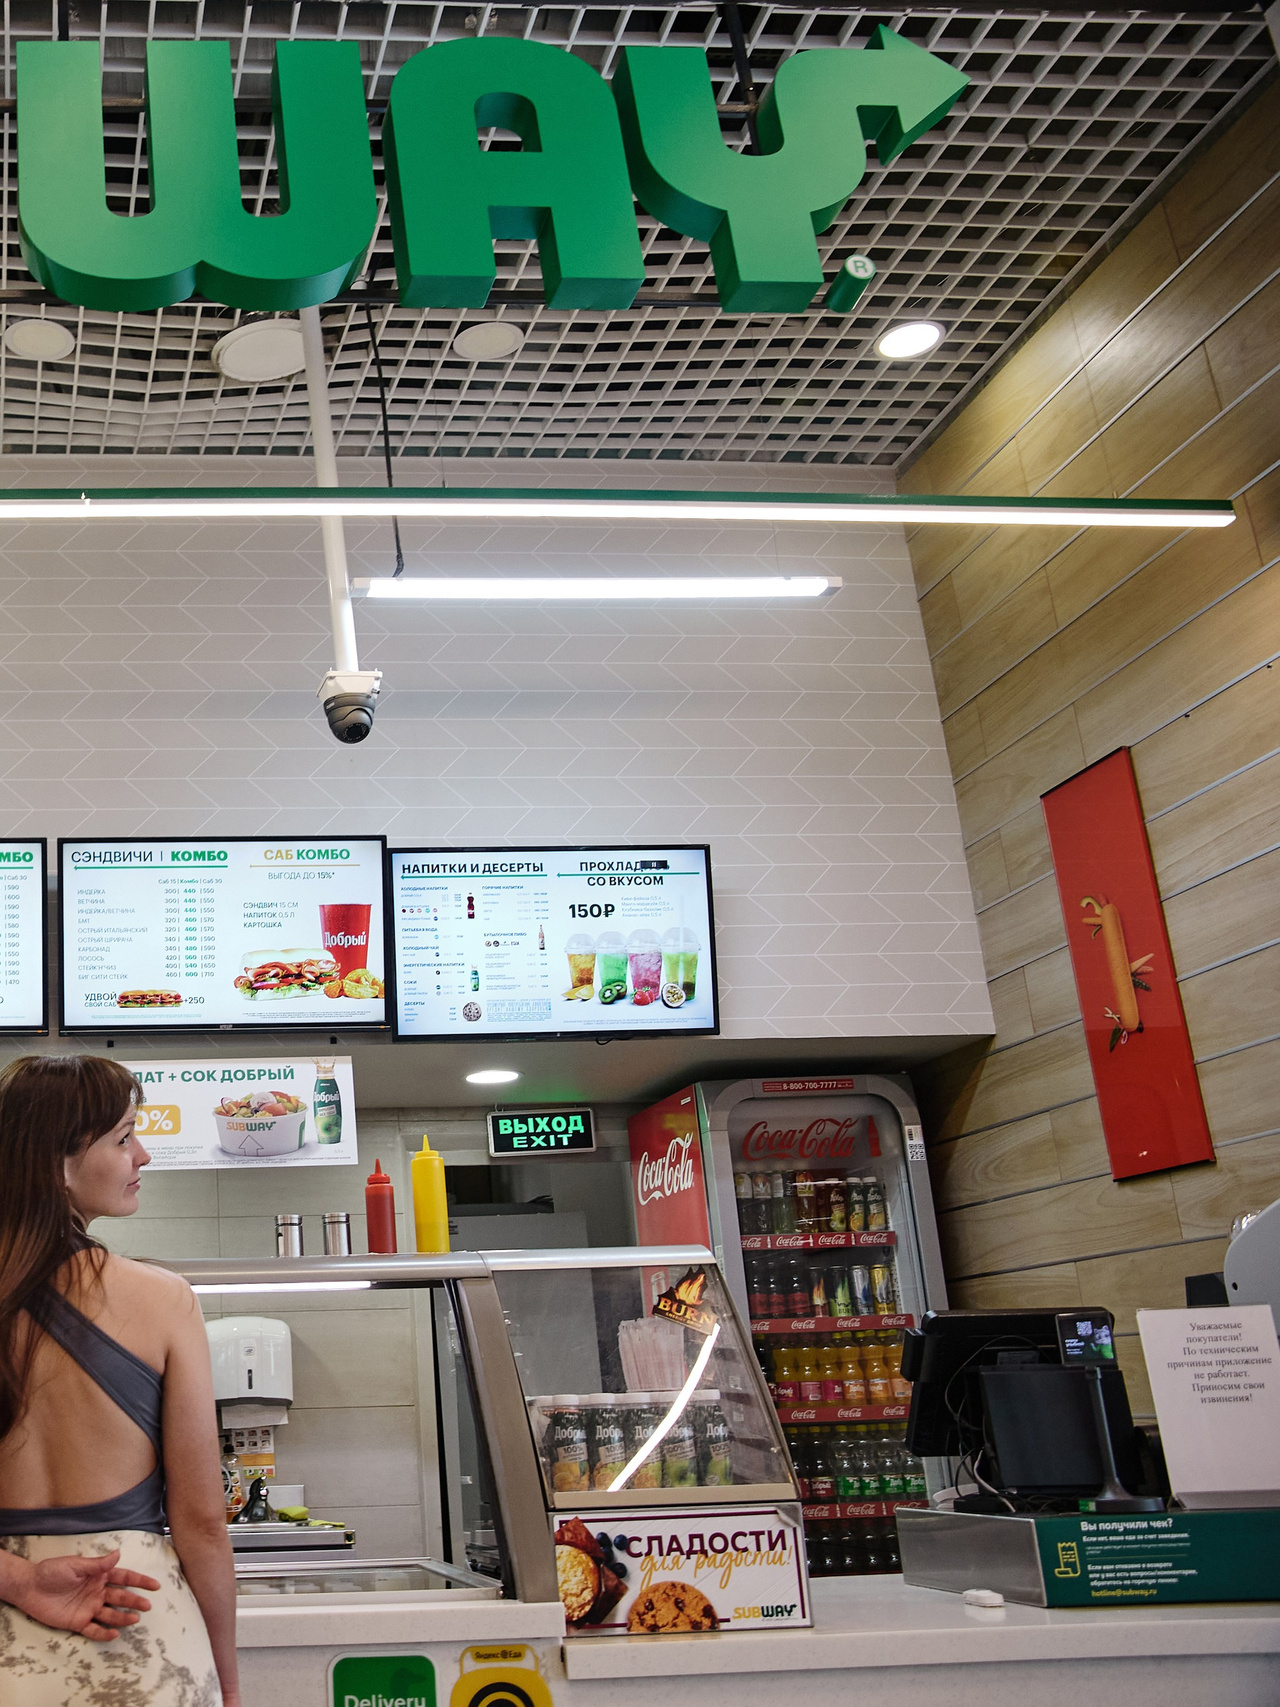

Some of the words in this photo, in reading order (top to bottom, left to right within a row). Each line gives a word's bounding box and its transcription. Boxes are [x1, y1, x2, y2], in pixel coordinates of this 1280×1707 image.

[71, 851, 153, 864] СЭНДВИЧИ
[171, 850, 228, 862] КОМБО
[264, 849, 293, 860] САБ
[297, 849, 350, 860] КОМБО
[402, 864, 466, 874] НАПИТКИ
[471, 864, 479, 873] И
[482, 863, 543, 874] ДЕСЕРТЫ
[580, 861, 669, 872] ПРОХЛАД
[268, 872, 301, 880] ВЫГОДА
[302, 872, 315, 880] ДО
[587, 877, 606, 886] СО
[609, 876, 664, 886] ВКУСОМ
[569, 903, 615, 918] 150₽
[325, 931, 366, 948] Добрый
[85, 992, 117, 1001] УДВОЙ
[184, 996, 205, 1004] +250
[133, 1071, 164, 1083] ЛАТ
[180, 1070, 217, 1083] СОК
[220, 1065, 295, 1084] ДОБРЫЙ
[226, 1121, 277, 1132] SUBWAY
[498, 1115, 585, 1135] ВЫХОД
[512, 1134, 573, 1148] EXIT
[742, 1116, 860, 1162] Coca-Cola
[638, 1131, 695, 1206] Coca-Cola
[776, 1235, 804, 1247] Coca-Cola
[818, 1234, 846, 1245] Coca-Cola
[860, 1233, 888, 1244] Coca-Cola
[658, 1297, 715, 1324] BURN
[791, 1319, 816, 1330] Coca-Cola
[837, 1317, 861, 1327] Coca-Cola
[881, 1316, 906, 1326] Coca-Cola
[1189, 1322, 1242, 1332] Уважаемые
[1186, 1333, 1242, 1344] покупатели!
[1183, 1347, 1196, 1356] По
[1199, 1345, 1259, 1354] техническим
[1167, 1360, 1213, 1370] причинам
[1215, 1357, 1272, 1369] приложение
[1207, 1370, 1251, 1380] работает.
[1192, 1382, 1240, 1393] Приносим
[1201, 1394, 1252, 1404] извинения!
[791, 1409, 817, 1420] Coca-Cola
[837, 1408, 862, 1418] Coca-Cola
[883, 1406, 905, 1416] Coca-Cola
[847, 1504, 876, 1515] Coca-Cola
[1080, 1521, 1097, 1531] Вы
[1099, 1520, 1148, 1532] получили
[1150, 1518, 1173, 1528] чек?
[625, 1529, 786, 1560] СЛАДОСТИ
[640, 1552, 686, 1591] для
[694, 1546, 793, 1589] радости!
[733, 1603, 798, 1620] SUBWAY
[475, 1651, 500, 1660] Яндекс
[344, 1694, 426, 1707] Delivery
